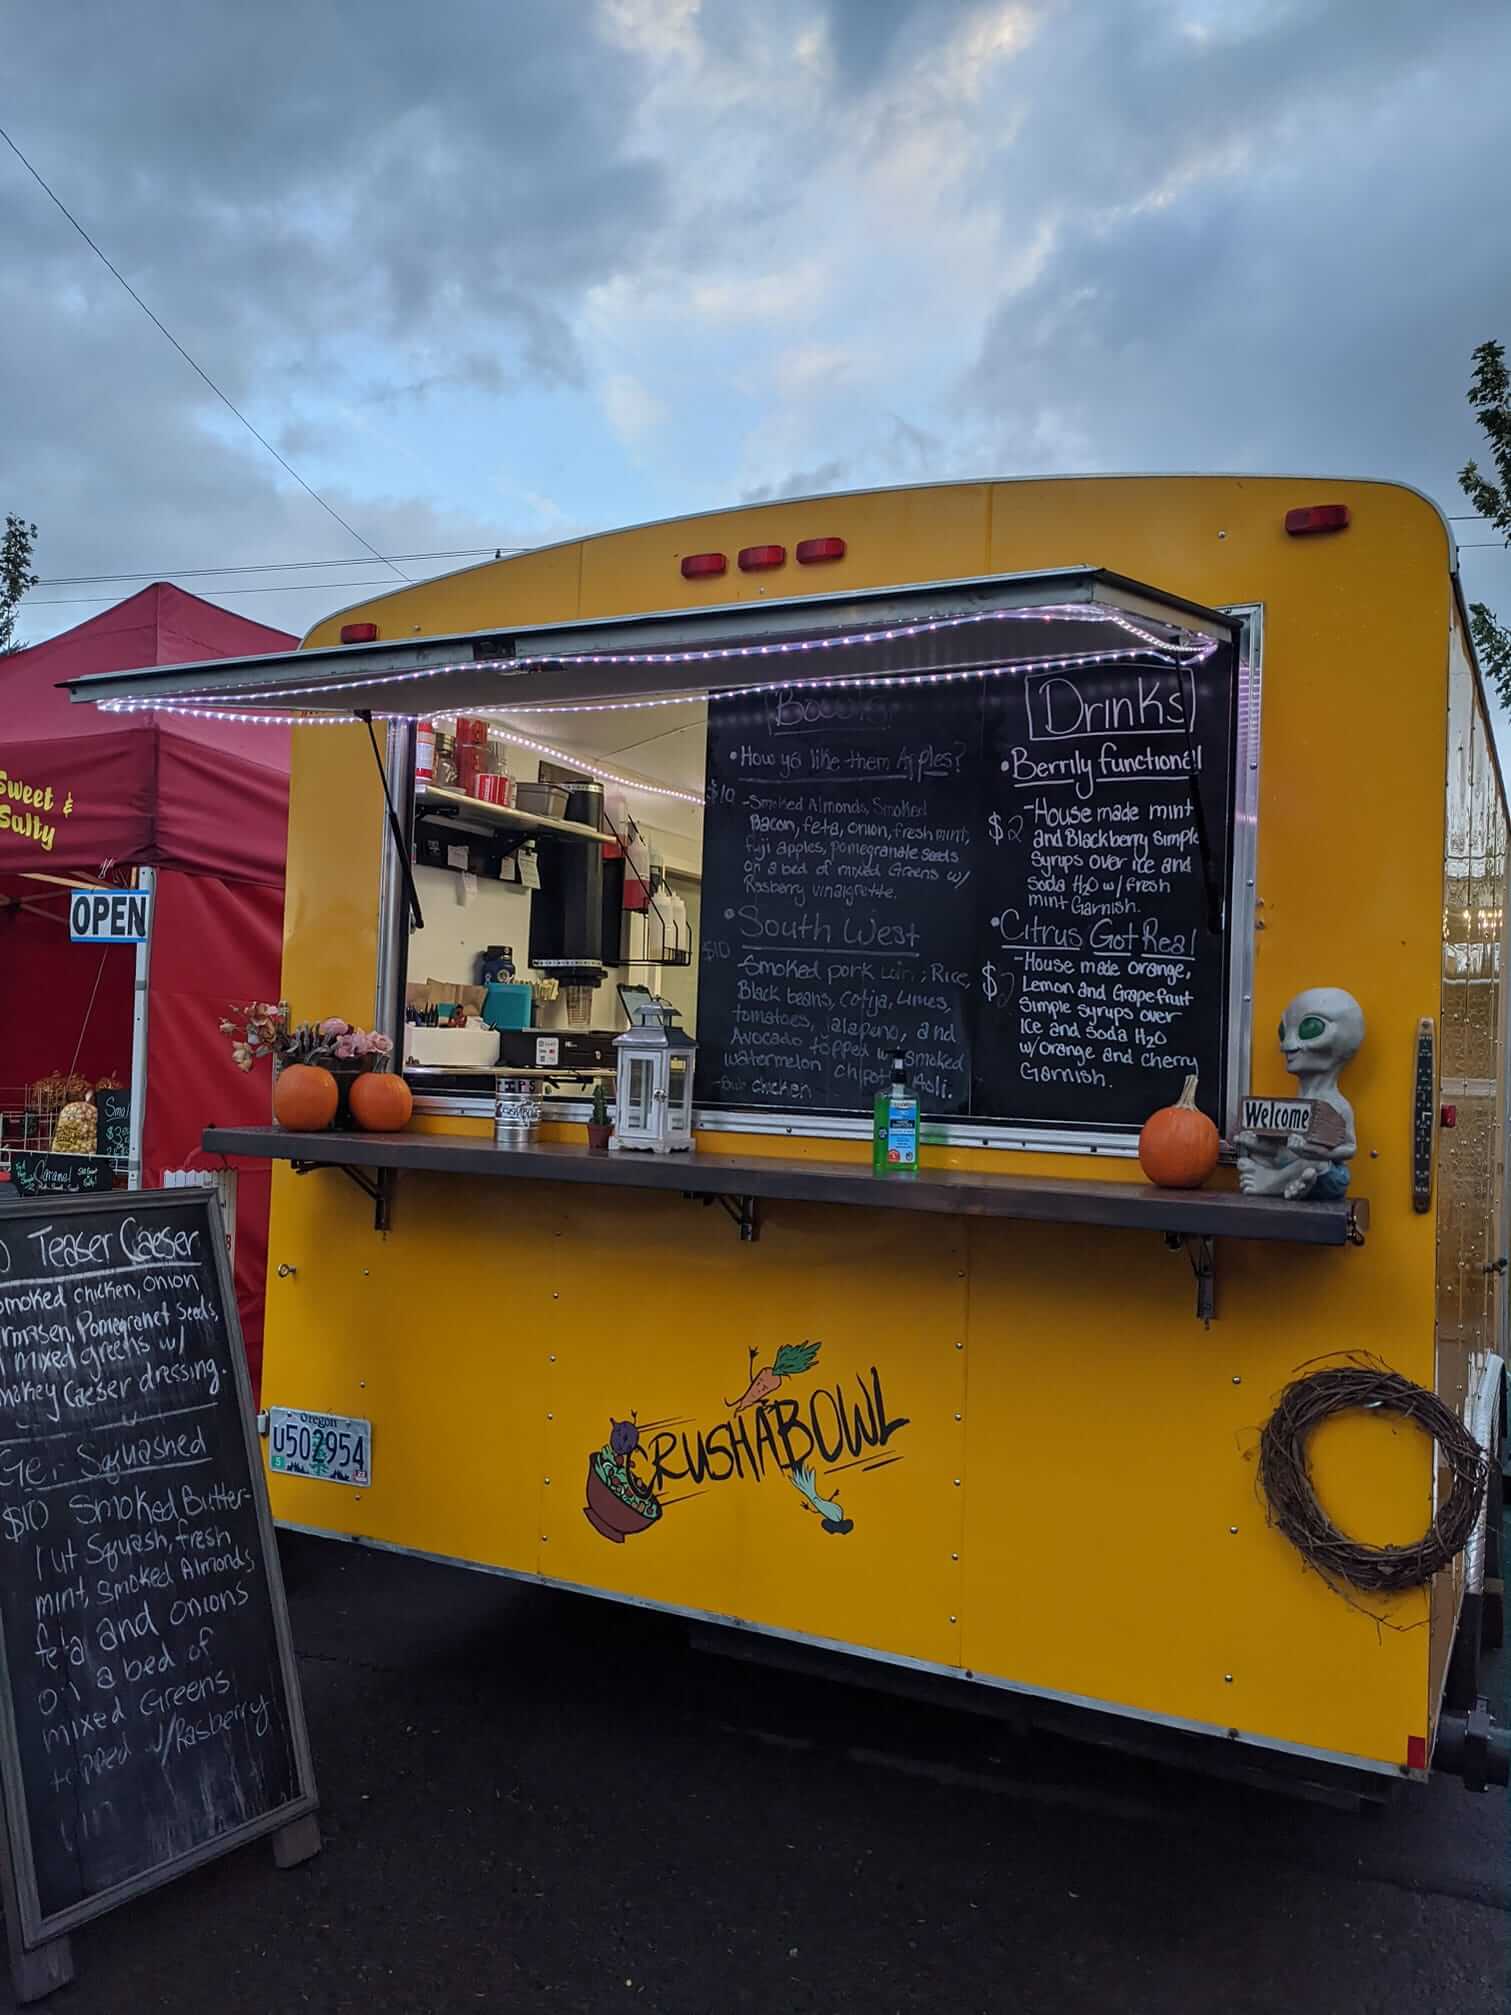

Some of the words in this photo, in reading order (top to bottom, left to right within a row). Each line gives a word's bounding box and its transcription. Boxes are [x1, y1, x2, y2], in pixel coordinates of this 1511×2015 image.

[740, 744, 776, 767] How
[1011, 746, 1094, 799] Berrily
[0, 769, 54, 812] Sweet
[1098, 802, 1140, 823] made
[1149, 797, 1195, 820] mint
[0, 805, 56, 851] Salty
[1033, 829, 1063, 849] and
[1066, 827, 1149, 862] Blackberry
[1088, 855, 1129, 872] over
[72, 896, 147, 937] OPEN
[1028, 893, 1070, 911] mint
[737, 904, 832, 943] South
[843, 915, 922, 948] West
[1001, 908, 1083, 948] Citrus
[1089, 917, 1139, 952] Got
[1142, 917, 1199, 956] Real
[1080, 959, 1121, 977] made
[1022, 975, 1074, 994] Lemon
[1077, 979, 1107, 1002] and
[917, 1021, 958, 1044] and
[1049, 1021, 1080, 1039] and
[1102, 1047, 1135, 1065] and
[1245, 1101, 1310, 1130] Welcome
[26, 1224, 114, 1267] Teaser
[142, 1273, 200, 1293] onion
[14, 1342, 78, 1375] mixed
[138, 1358, 228, 1396] dressing.
[300, 1413, 337, 1428] Oregon
[273, 1424, 365, 1472] U502954
[2, 1499, 50, 1542] $10
[175, 1517, 231, 1550] fresh
[96, 1600, 161, 1651] and
[96, 1666, 118, 1689] a
[122, 1639, 176, 1682] bed
[187, 1625, 215, 1663] of
[42, 1694, 128, 1754] mixed
